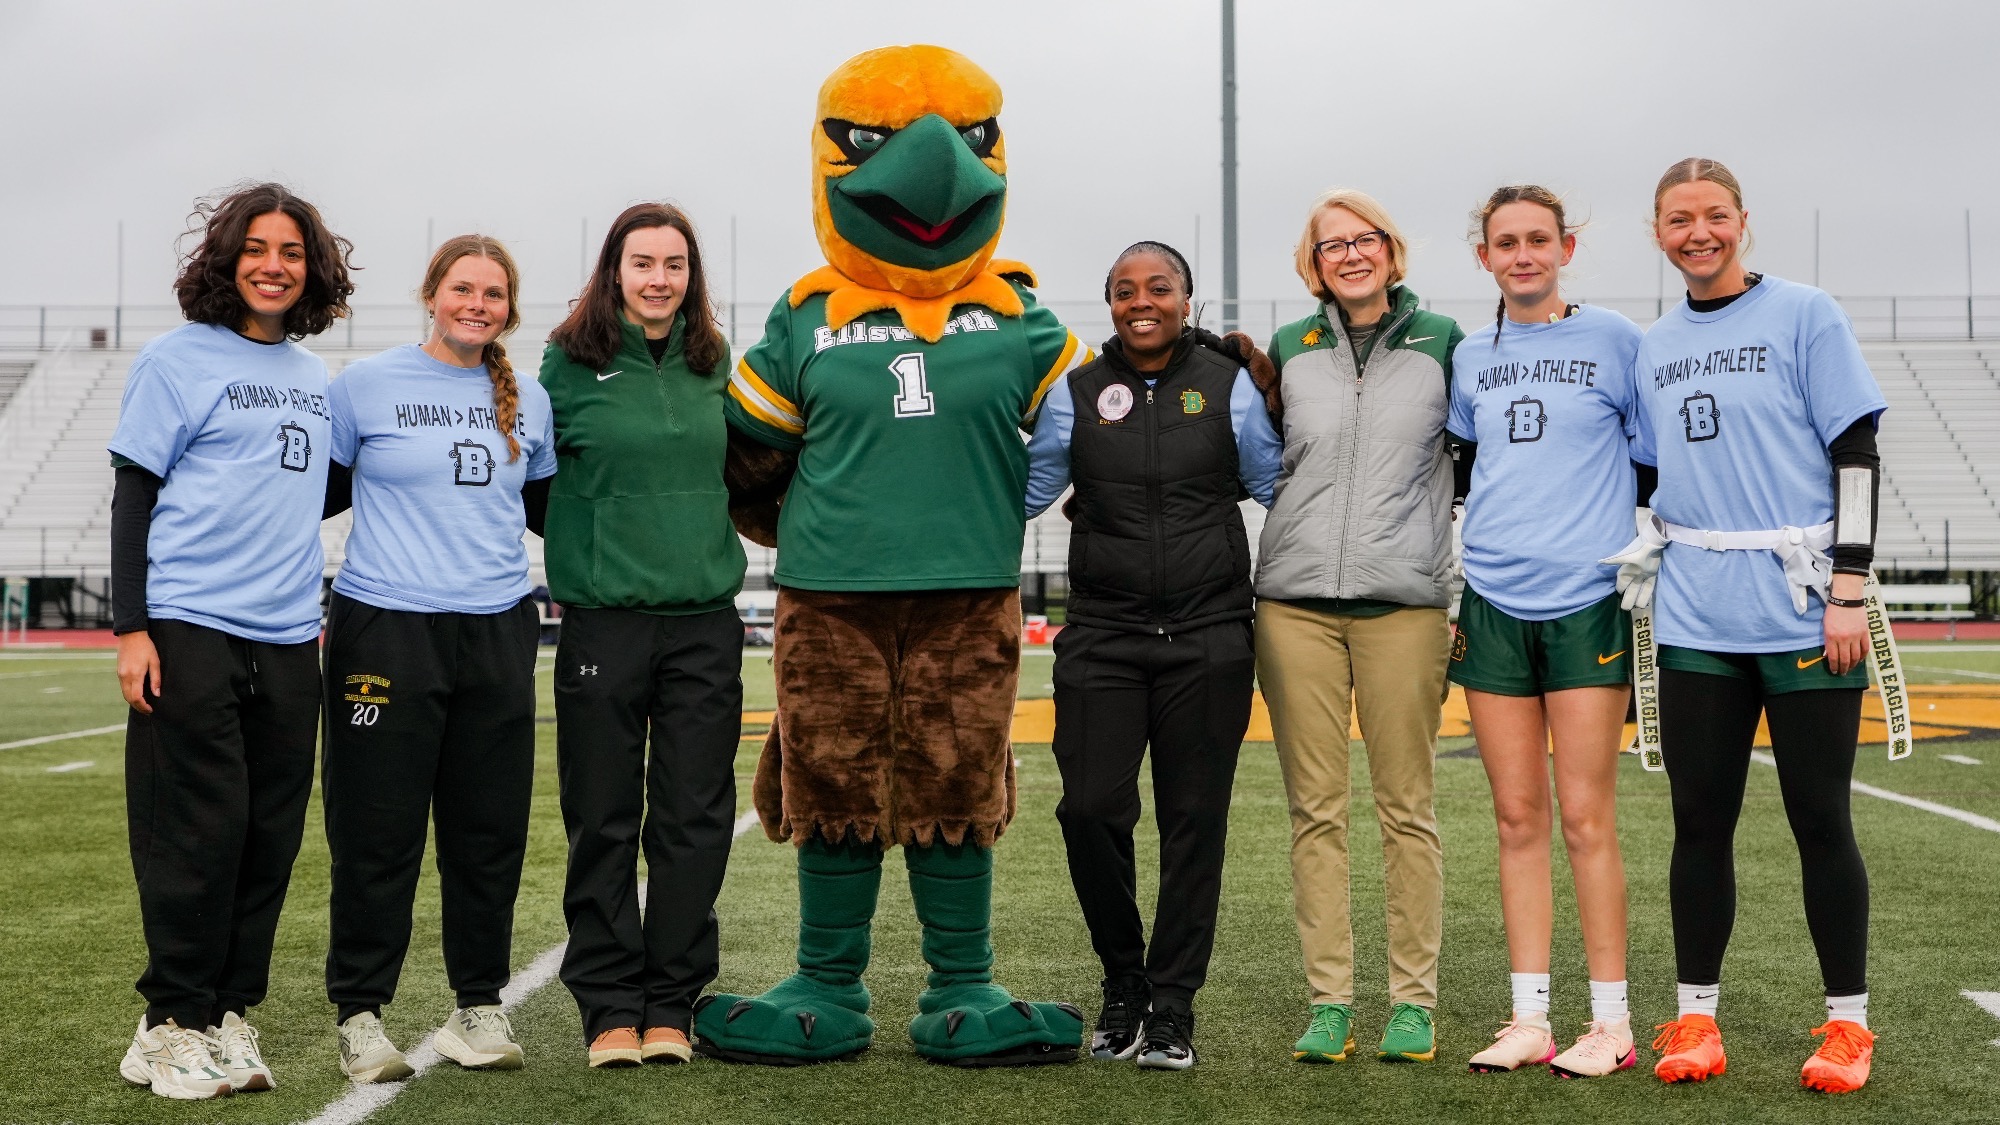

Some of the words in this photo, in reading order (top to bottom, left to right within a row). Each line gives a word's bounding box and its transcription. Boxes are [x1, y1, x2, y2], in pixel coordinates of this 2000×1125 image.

[814, 310, 999, 353] Ellswrth
[888, 353, 935, 418] 1
[1476, 362, 1519, 393] HUMAN
[1531, 360, 1597, 387] ATHLETE
[1654, 356, 1692, 392] HUMAN
[1702, 346, 1767, 376] ATHLETE
[227, 385, 280, 411] HUMAN
[288, 387, 330, 421] ATHLETE
[396, 404, 452, 428] HUMAN
[468, 407, 525, 436] ATHE
[1181, 390, 1205, 413] B
[1507, 397, 1546, 443] B
[1681, 392, 1719, 442] B
[279, 423, 311, 472] B
[452, 440, 493, 486] B
[1635, 617, 1649, 629] 32
[1636, 629, 1654, 683] GOLDEN
[1866, 609, 1895, 672] GOLDEN
[1881, 672, 1906, 734] EAGLES
[350, 703, 379, 726] 20
[1639, 685, 1659, 744] EAGLES
